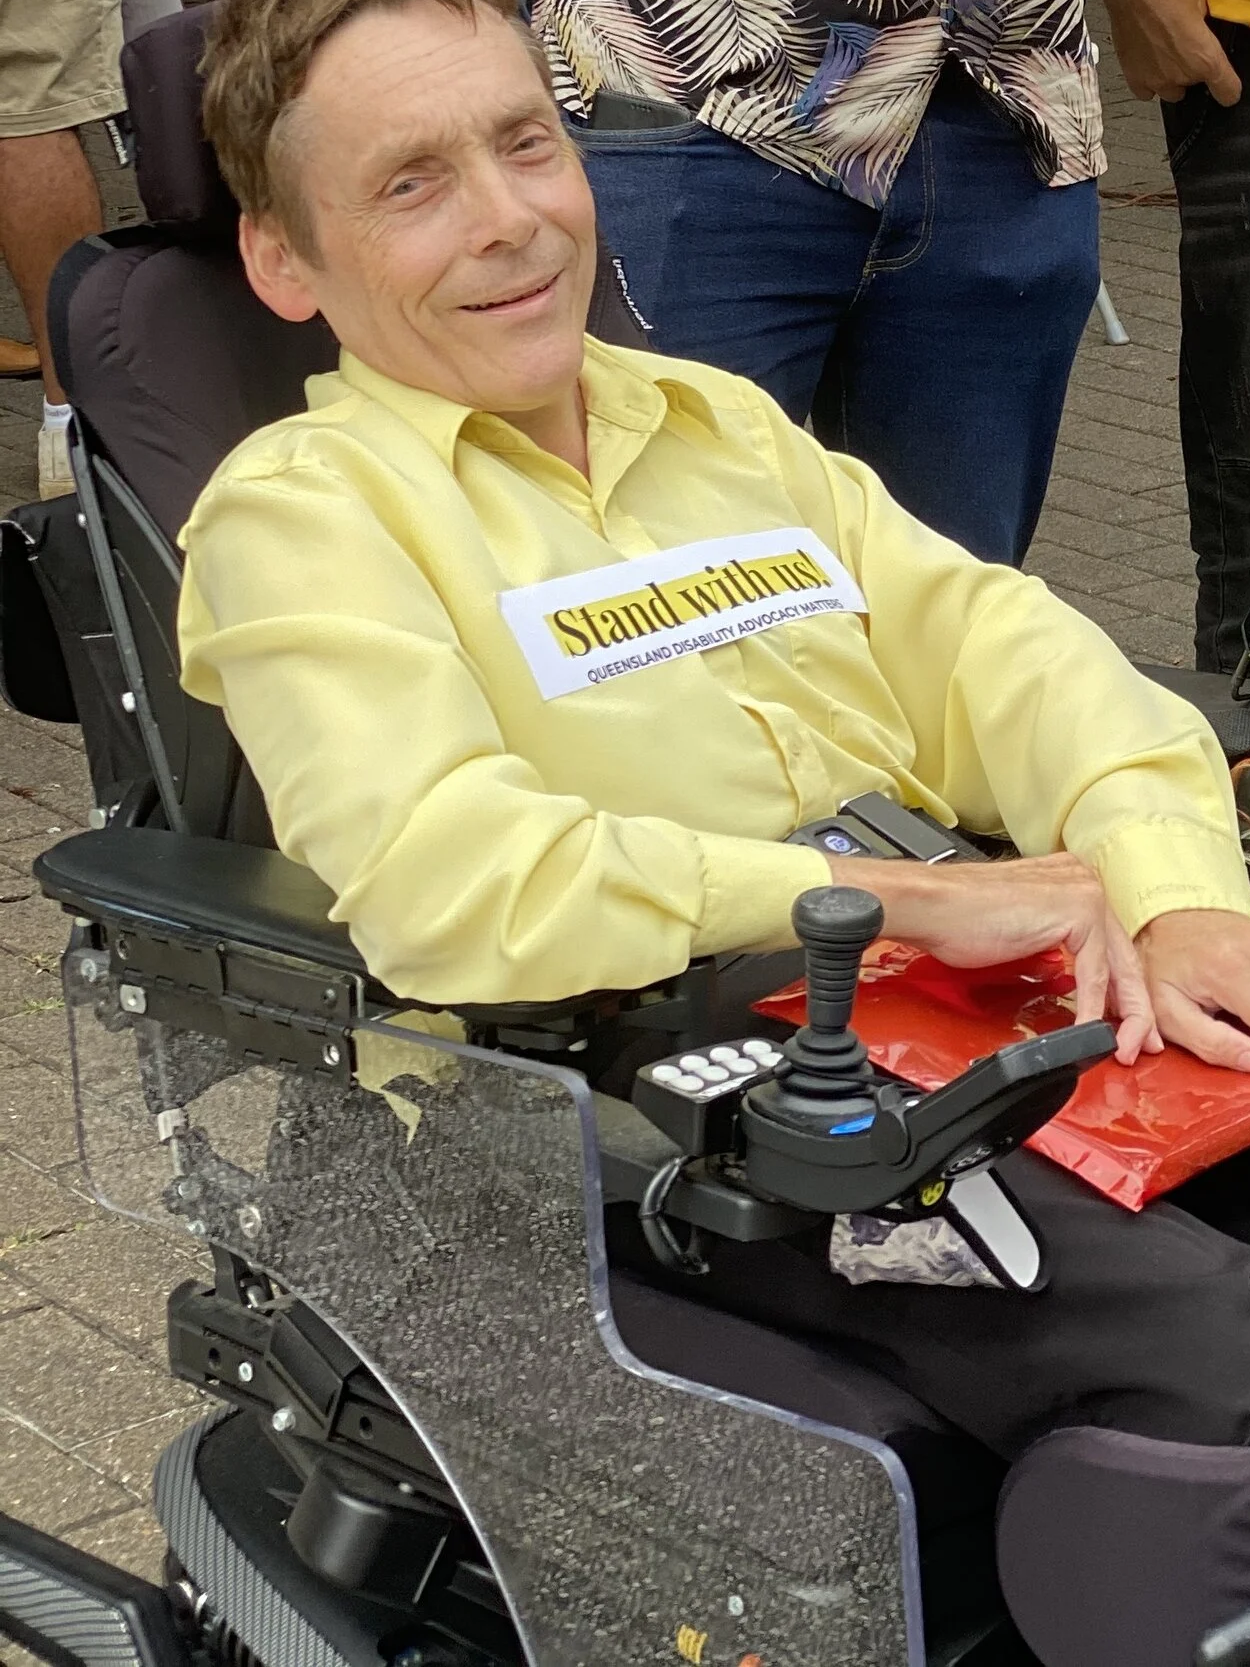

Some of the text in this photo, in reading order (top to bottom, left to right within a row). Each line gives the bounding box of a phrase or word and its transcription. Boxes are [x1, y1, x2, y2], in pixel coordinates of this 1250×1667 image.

[553, 549, 834, 658] Stand with us!
[587, 598, 845, 683] QUEENSLAND DISABILITY ADVOCACY MATTERS
